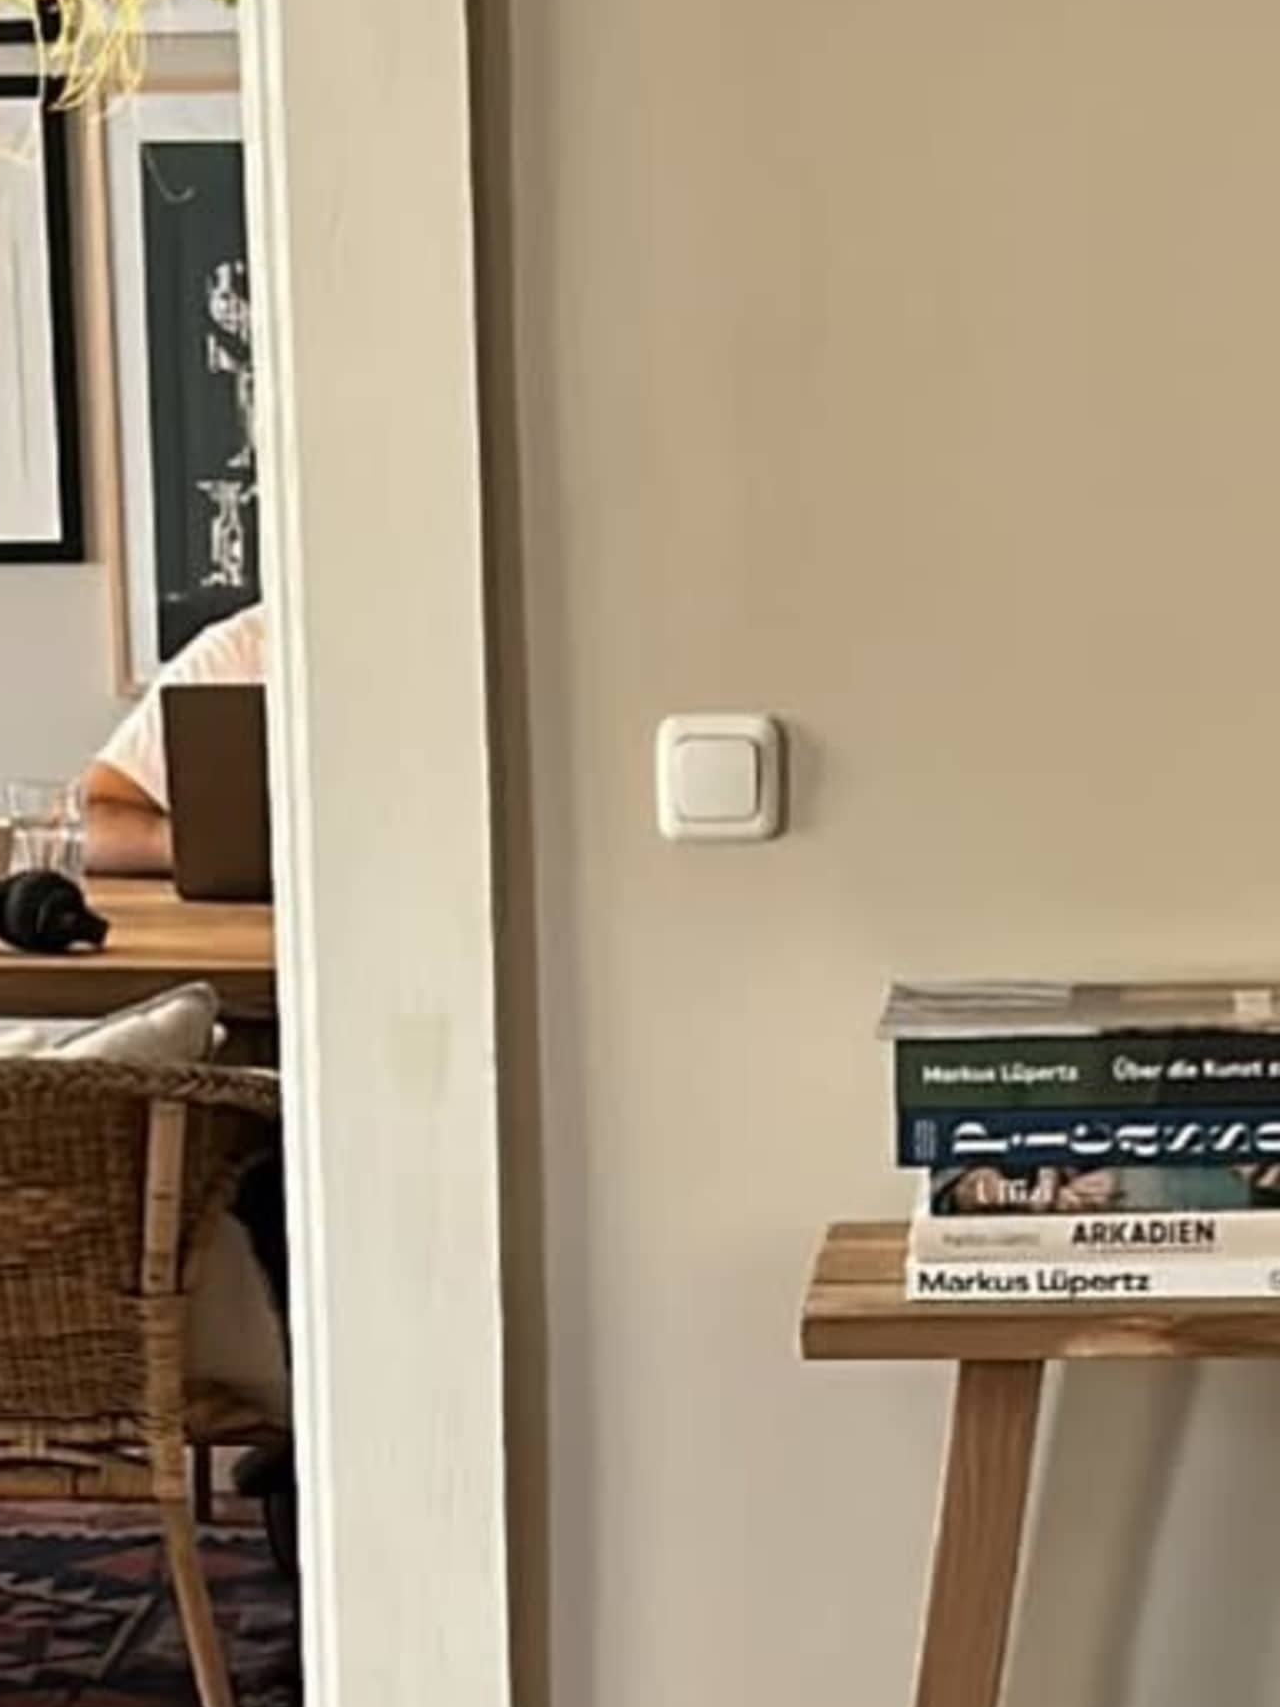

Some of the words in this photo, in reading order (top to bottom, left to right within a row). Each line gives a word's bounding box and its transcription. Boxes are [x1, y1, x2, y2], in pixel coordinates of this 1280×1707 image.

[922, 1065, 995, 1083] Markus
[1000, 1062, 1079, 1085] Lüpertz
[1071, 1220, 1216, 1245] ARKADIEN
[918, 1270, 1029, 1291] Markus
[1036, 1268, 1150, 1296] Lüpertz
